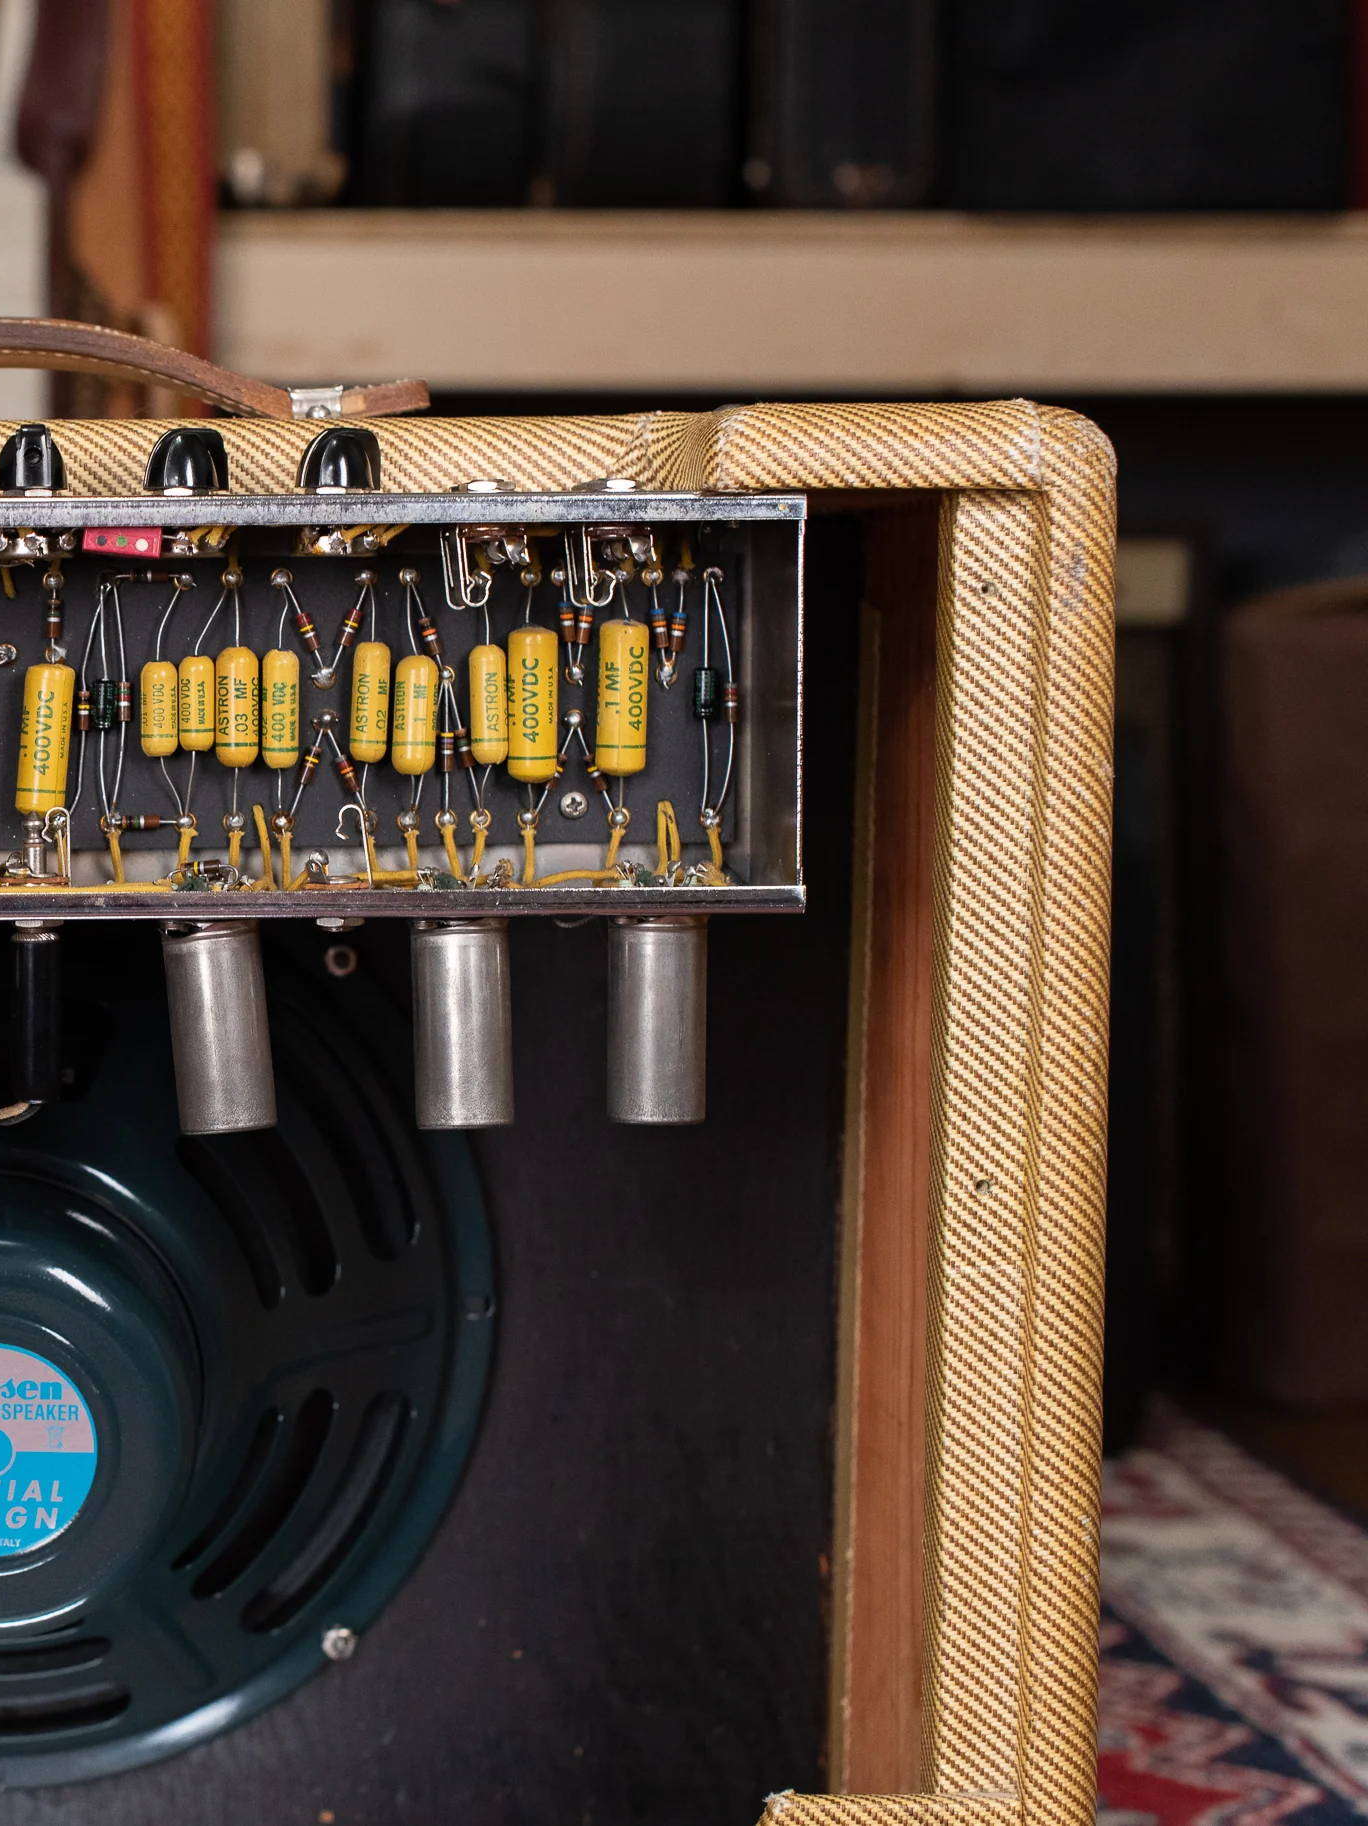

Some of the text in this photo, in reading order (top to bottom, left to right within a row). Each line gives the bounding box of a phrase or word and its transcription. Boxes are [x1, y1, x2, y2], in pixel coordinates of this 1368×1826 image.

[152, 683, 165, 729] 400 VDC
[181, 678, 191, 723] 400 VDC
[218, 675, 229, 736] ASTRON
[234, 678, 248, 736] .03 MF
[271, 682, 287, 743] 400 VDC
[289, 708, 296, 716] IN
[355, 673, 370, 733] ASTRON
[377, 679, 387, 695] MF
[394, 681, 405, 731] ASTRON
[413, 683, 427, 699] MF
[484, 672, 499, 732] ASTRON
[522, 658, 539, 743] 400VDC
[548, 690, 553, 698] IN
[605, 662, 620, 714] .1 MF
[628, 646, 644, 731] 400VDC
[33, 690, 55, 776] 400VDC
[62, 725, 67, 733] IN
